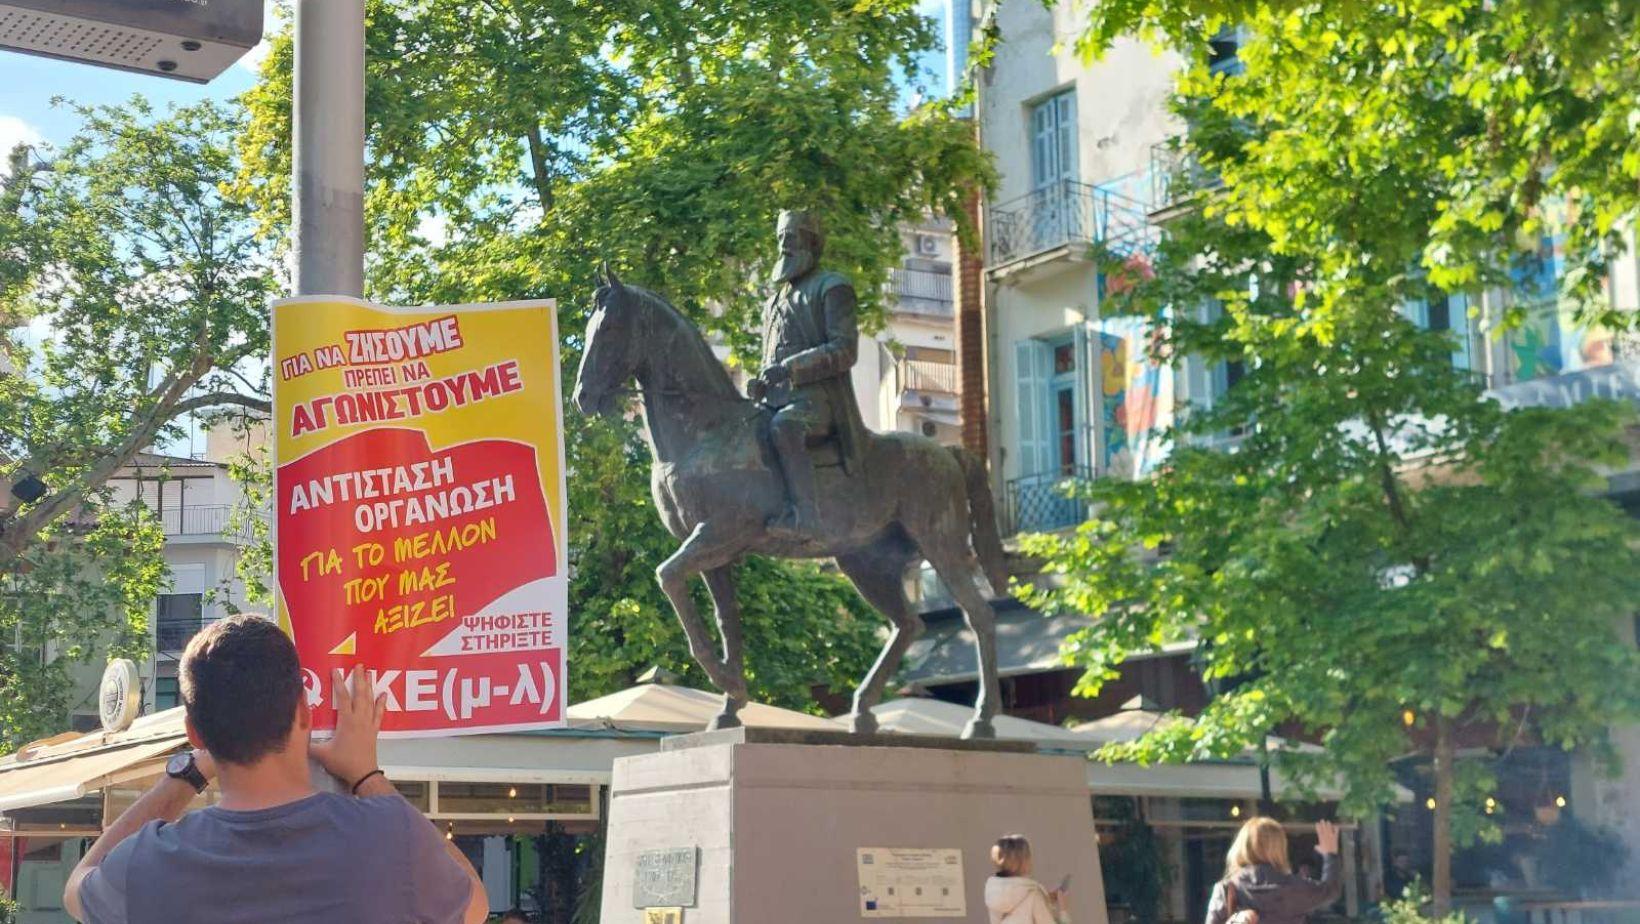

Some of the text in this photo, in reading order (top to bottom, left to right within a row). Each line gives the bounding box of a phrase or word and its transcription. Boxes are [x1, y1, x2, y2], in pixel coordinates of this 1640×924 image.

[281, 317, 461, 380] ΓΙΑ ΝΑ ΖΗΣΟΥΜΕ
[292, 361, 521, 436] ΑΓΩΝΙΣΤΟΥΜΕ
[344, 362, 430, 388] ΠΡΕΠΕΙ ΝΑ
[290, 456, 454, 514] ΑΝΤΙΣΤΑΣΗ
[355, 474, 515, 532] ΟΡΓΑΝΩΣΗ
[300, 517, 496, 582] ΓΙΑ ΤΟ ΜΕΛΛΟΝ
[343, 561, 456, 606] ΠΟΥ ΜΑΣ
[373, 594, 455, 635] ΑΞΙΖΕΙ
[463, 612, 553, 632] ΨΗΦΙΣΤΕ
[460, 631, 553, 651] ΣΤΗΡΙΞΤΕ
